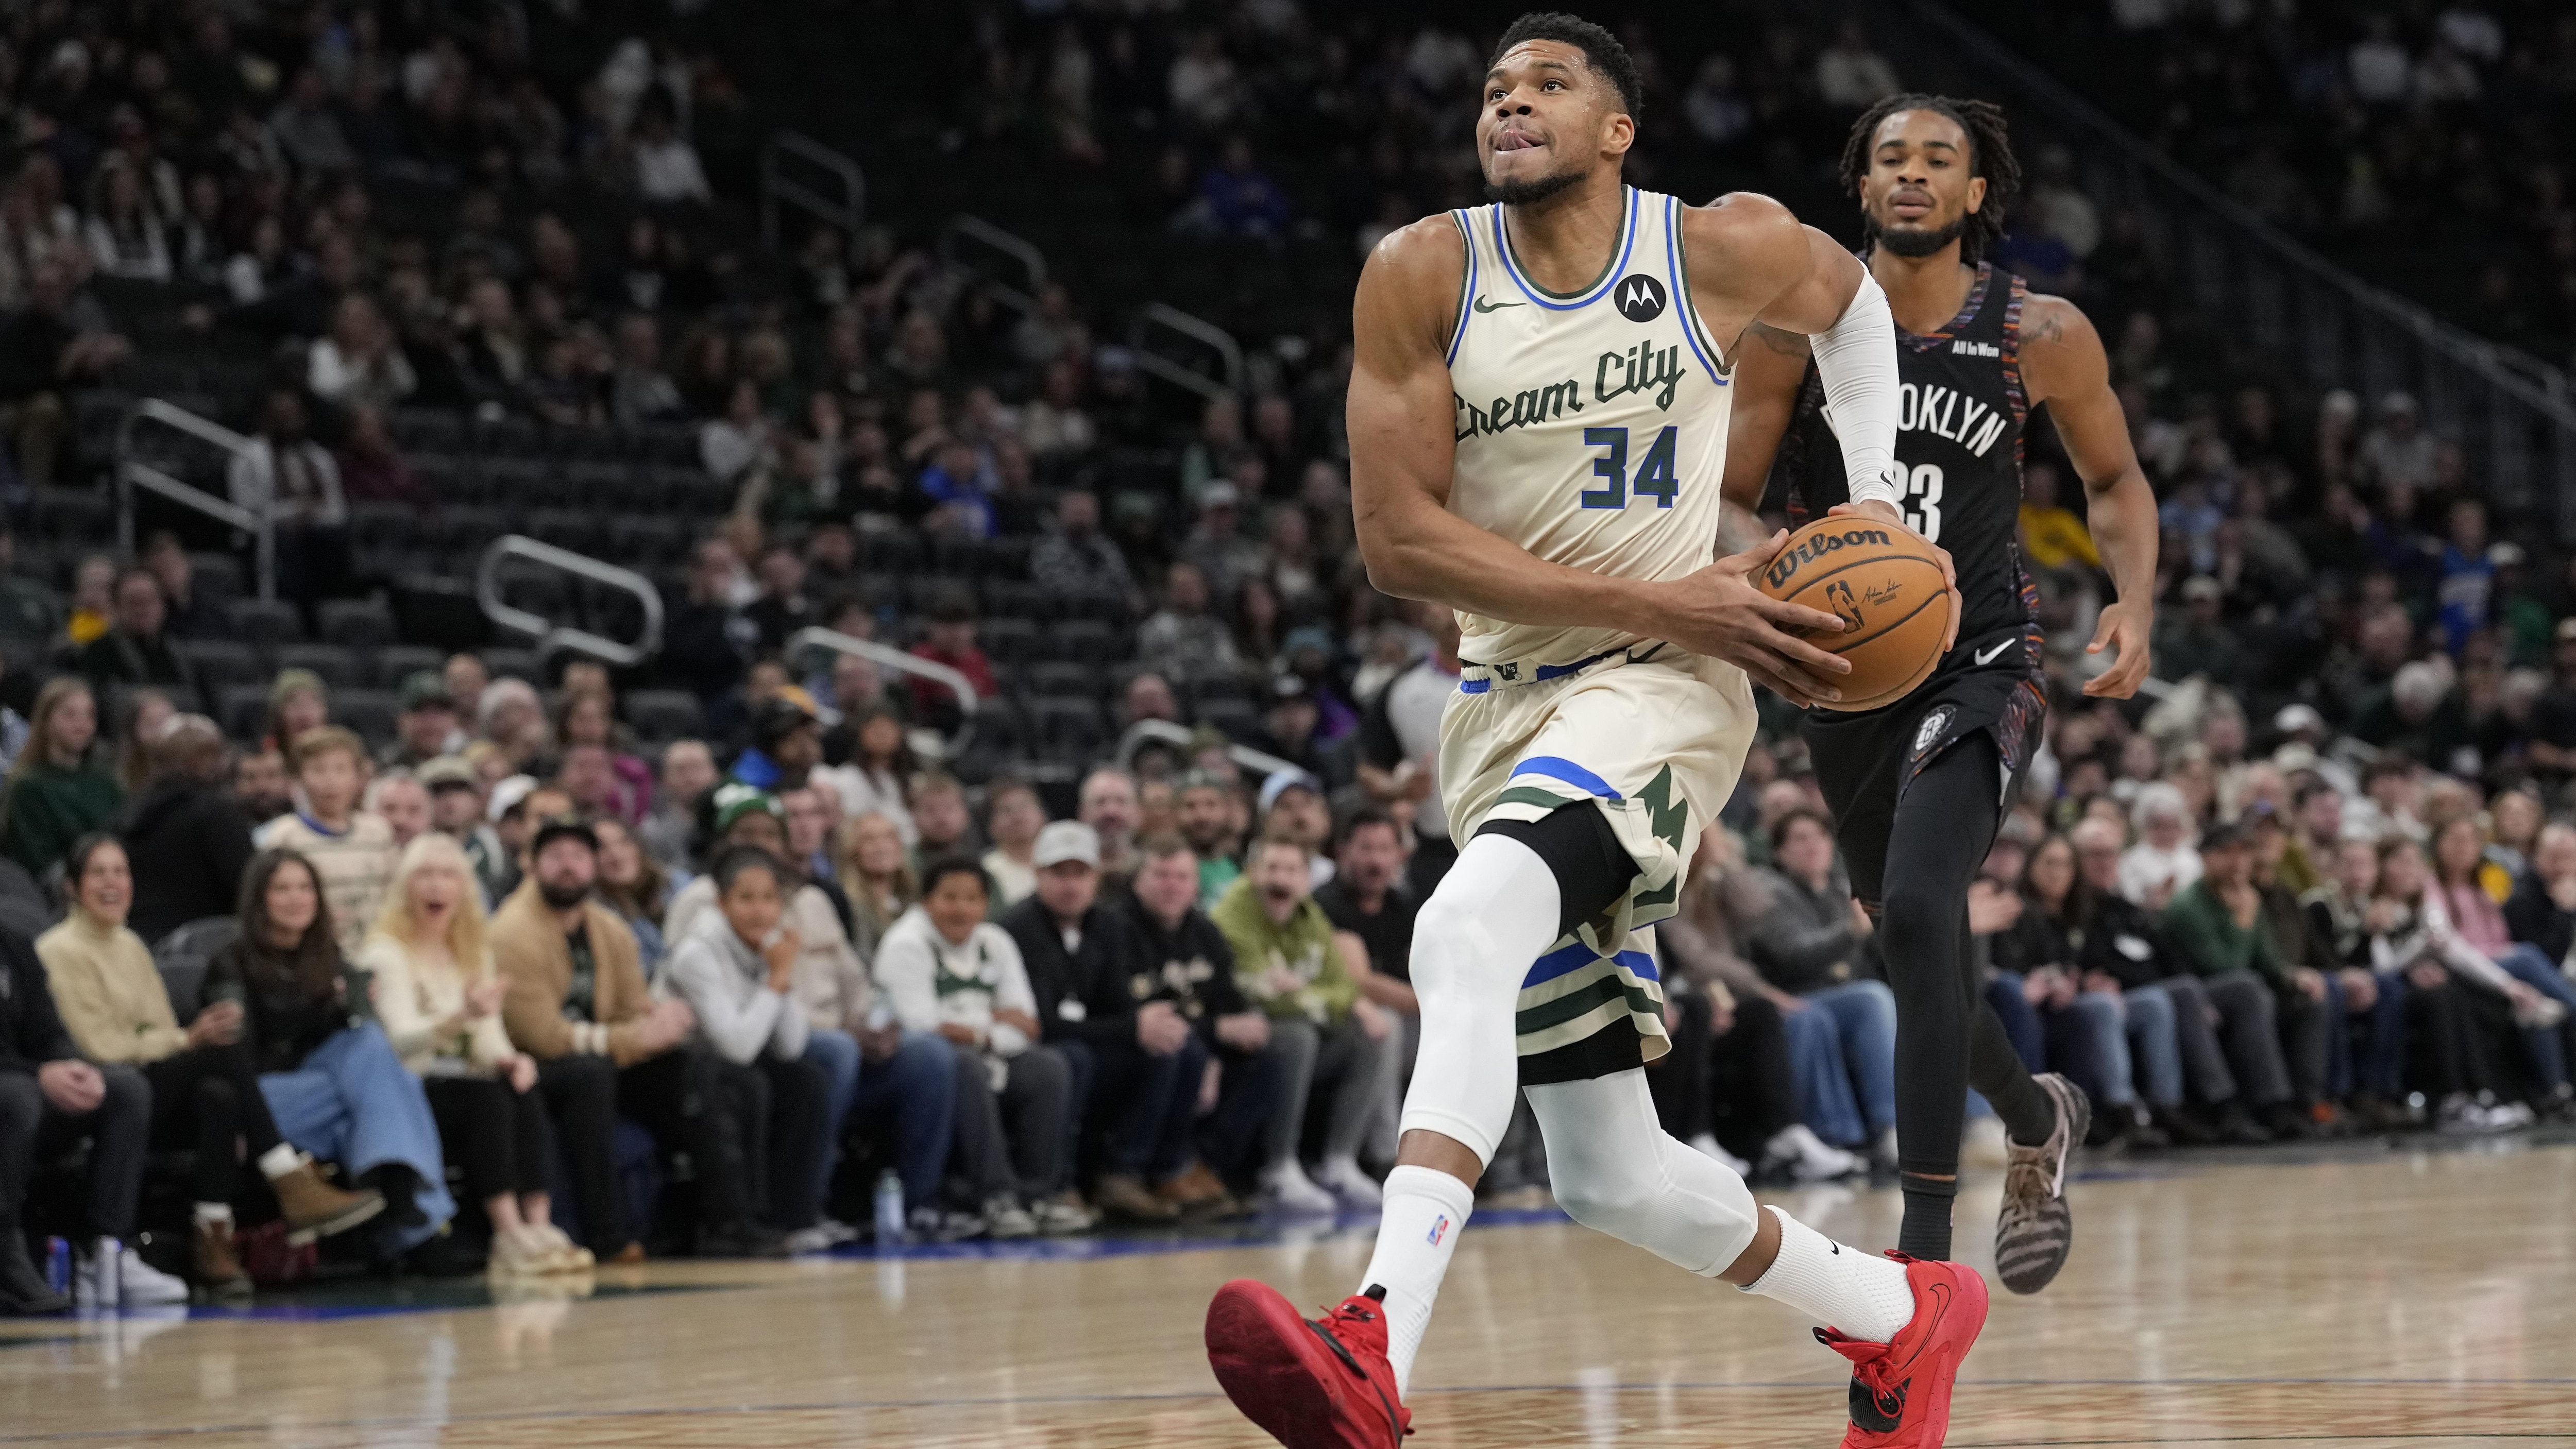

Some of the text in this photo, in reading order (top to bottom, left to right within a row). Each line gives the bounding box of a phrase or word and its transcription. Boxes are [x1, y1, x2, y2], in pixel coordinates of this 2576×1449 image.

[1952, 339, 1967, 354] All
[1453, 339, 1686, 443] Cream City
[1819, 382, 2007, 458] OKLYN
[1581, 425, 1679, 509] 34
[1766, 529, 1893, 589] Wilson
